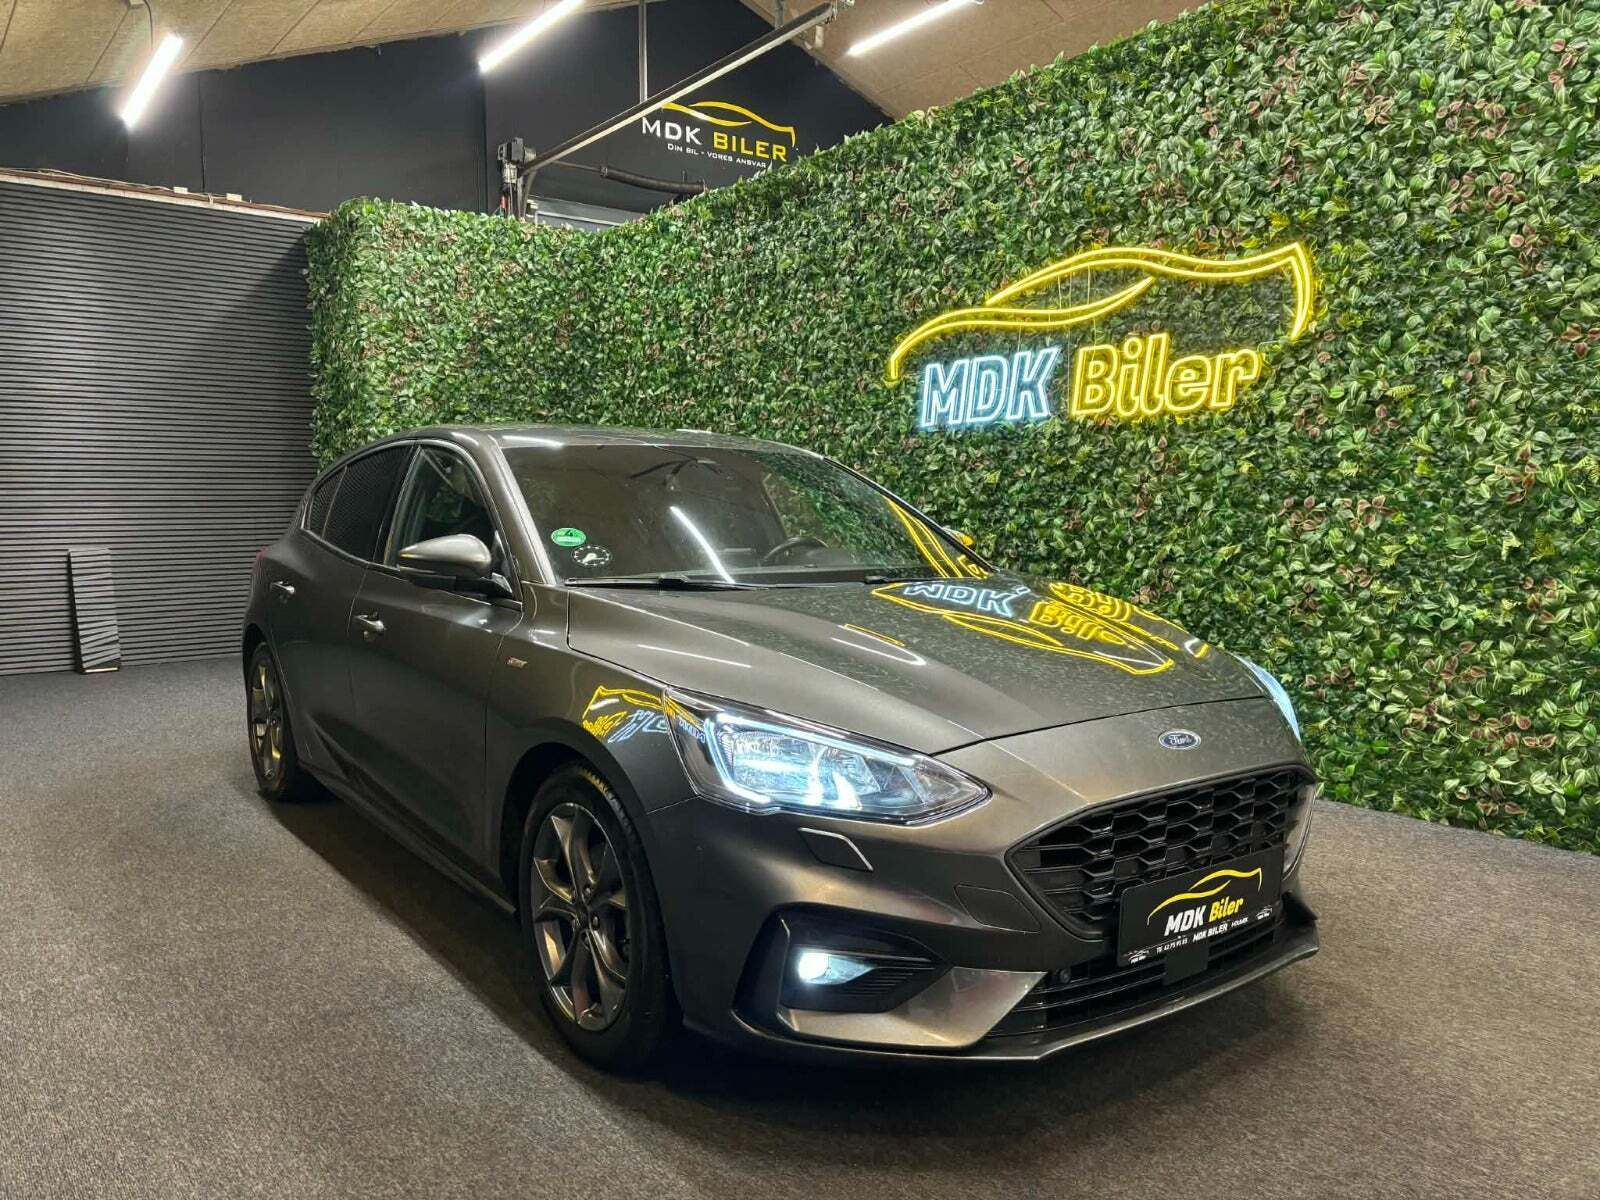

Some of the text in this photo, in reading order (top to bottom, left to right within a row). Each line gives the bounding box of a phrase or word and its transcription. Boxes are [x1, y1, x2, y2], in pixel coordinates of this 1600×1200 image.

[641, 116, 787, 162] MDK BILER
[707, 151, 733, 162] VORES
[735, 154, 767, 168] ANSVAR
[919, 332, 1264, 430] MDK Biler
[1164, 895, 1244, 936] MDK Biler
[1207, 922, 1228, 937] BILER
